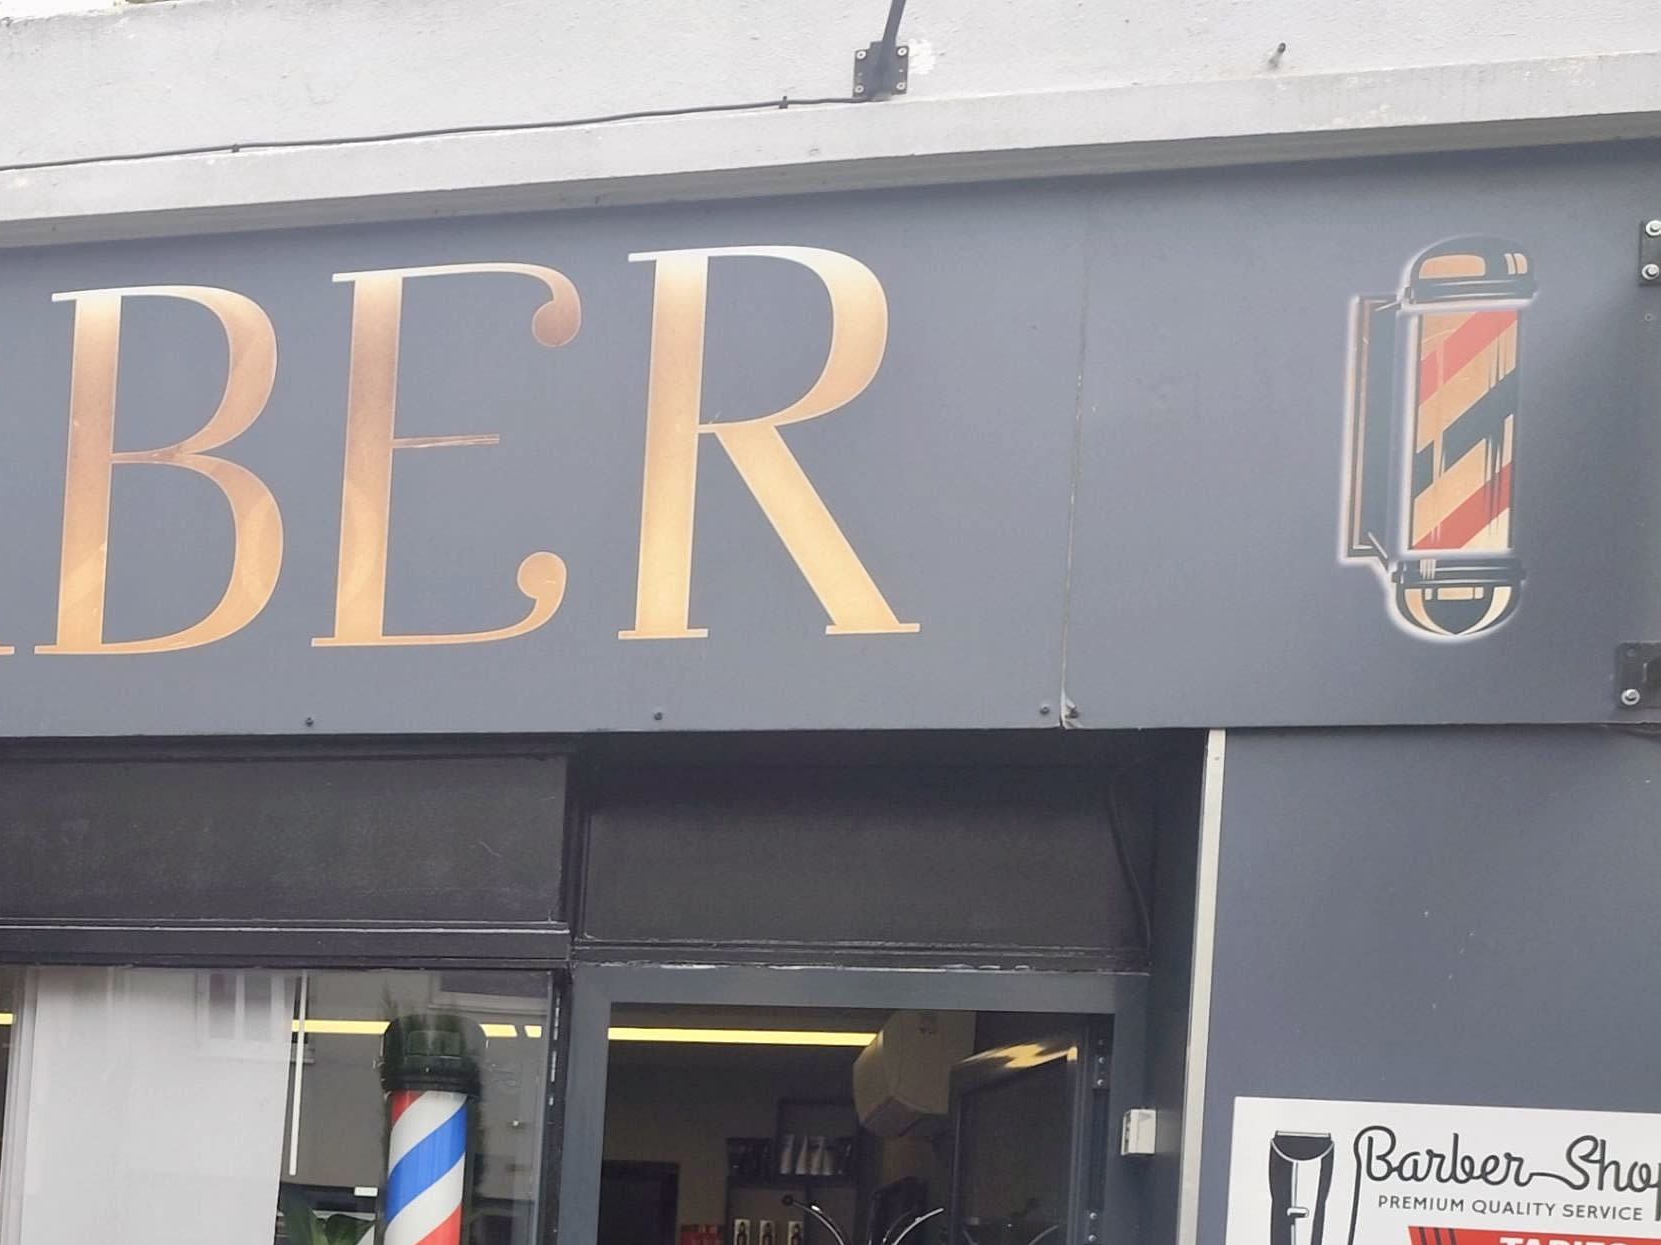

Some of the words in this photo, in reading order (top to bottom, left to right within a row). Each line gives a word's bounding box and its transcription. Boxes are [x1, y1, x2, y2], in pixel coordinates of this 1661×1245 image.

[1354, 1125, 1533, 1186] Barber
[1378, 1195, 1464, 1212] PREMIUM
[1471, 1199, 1556, 1217] QUALITY
[1562, 1204, 1643, 1221] SERVICE
